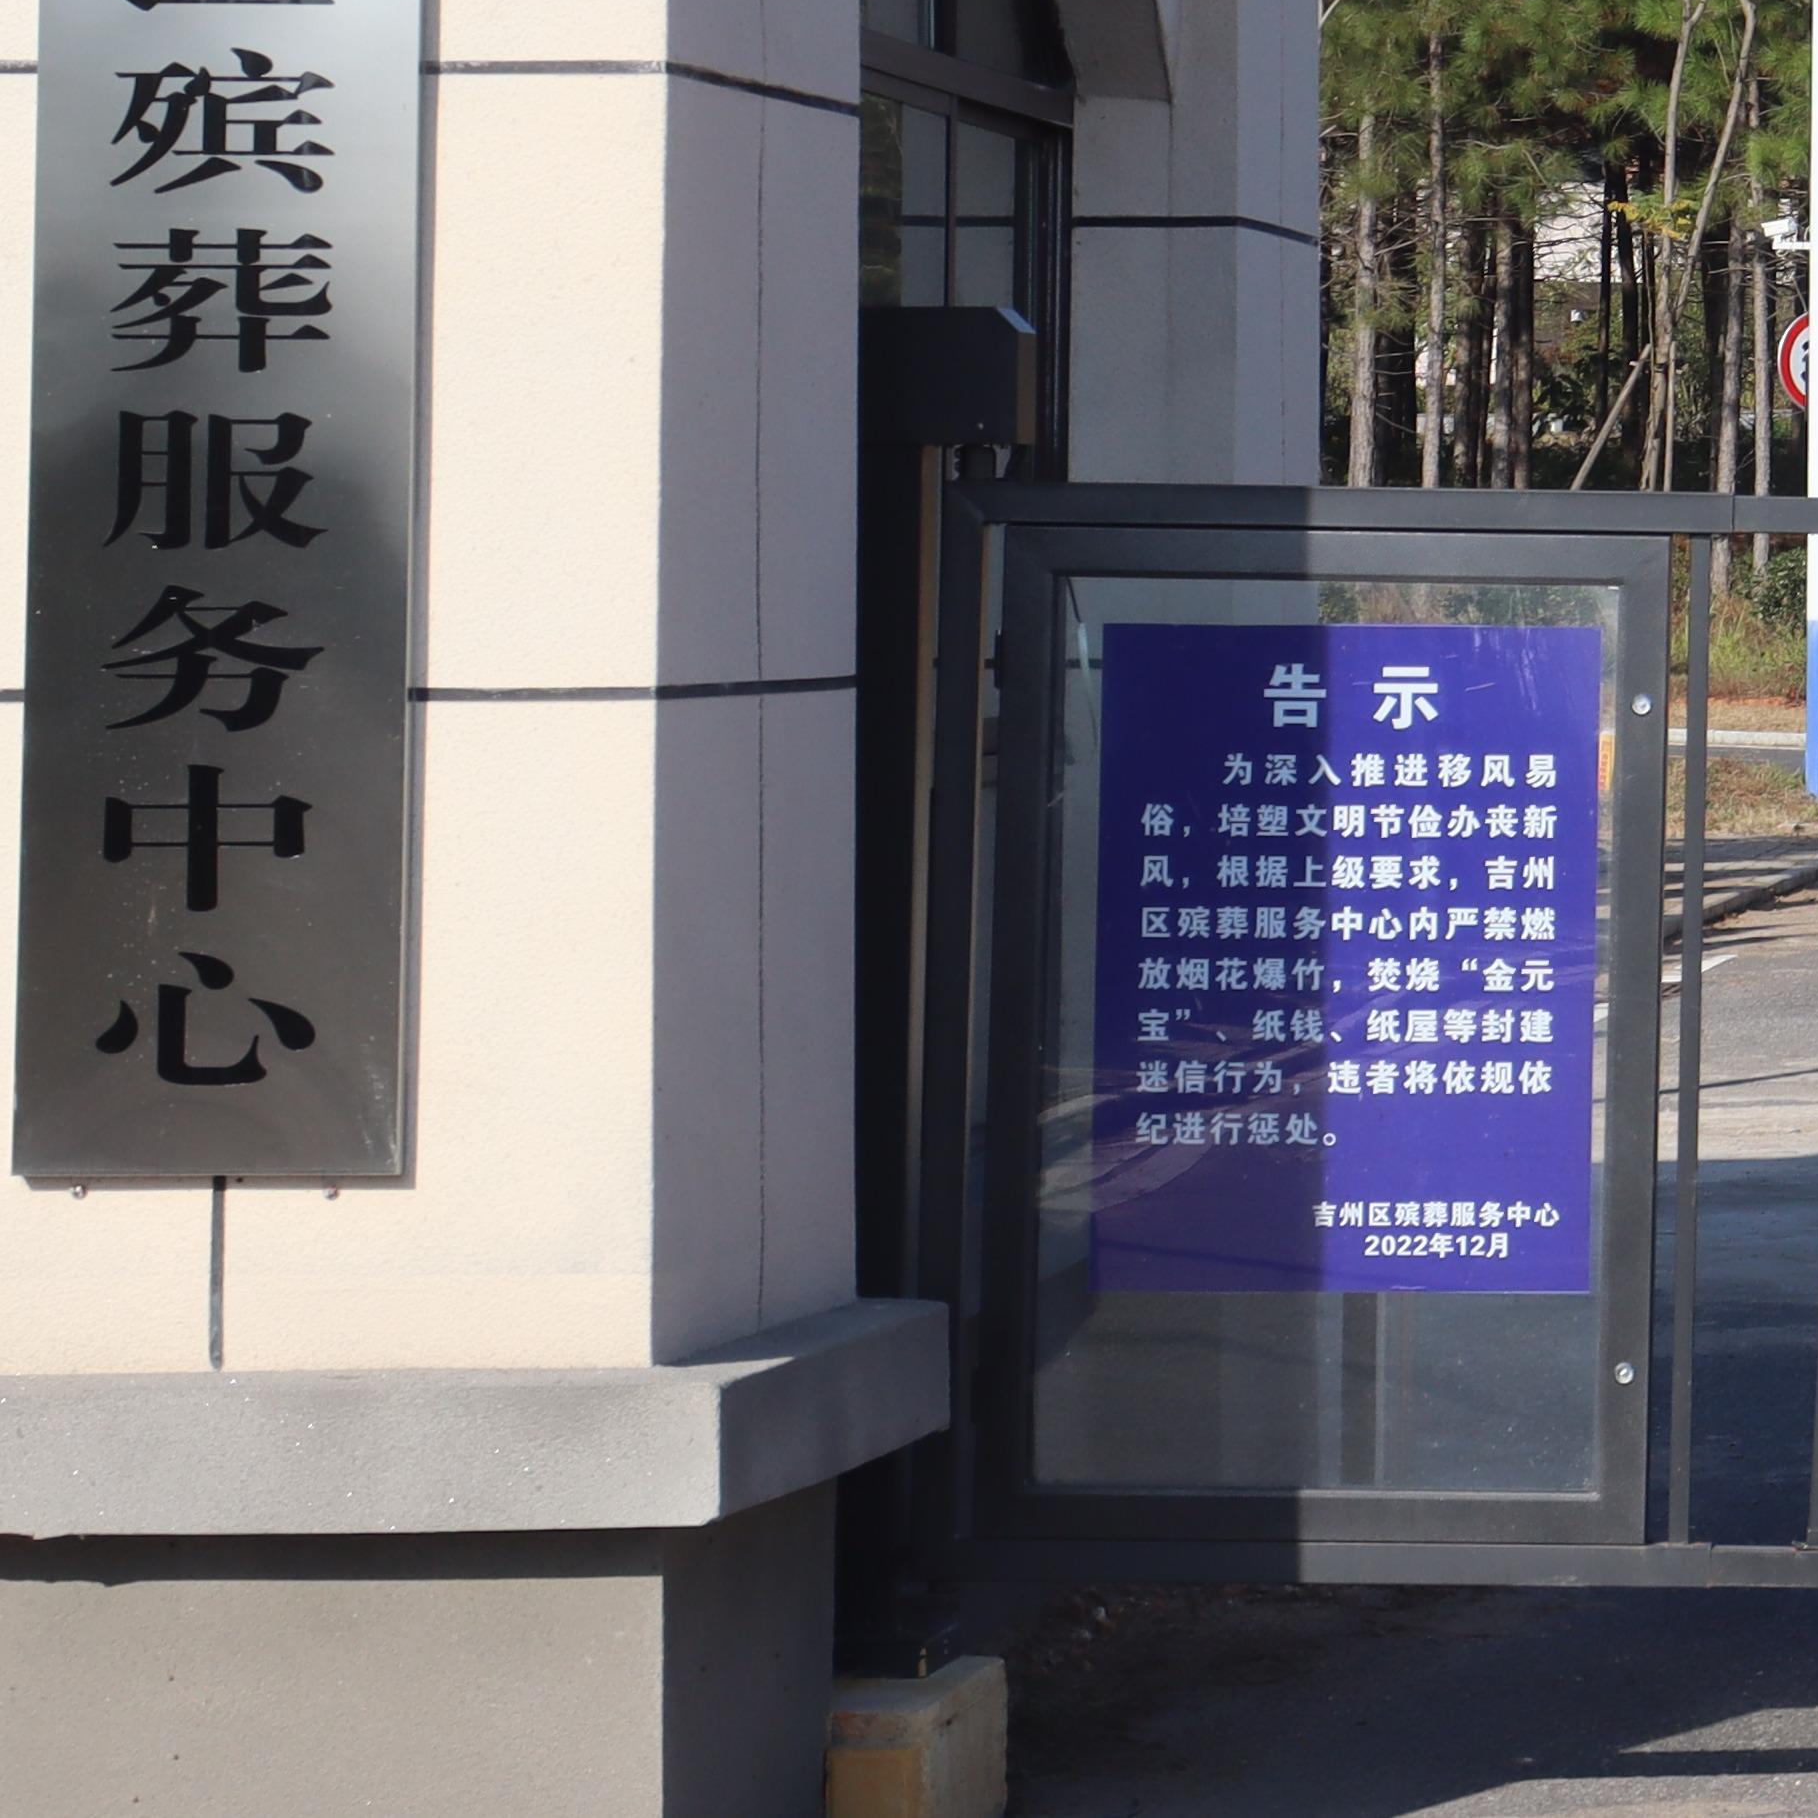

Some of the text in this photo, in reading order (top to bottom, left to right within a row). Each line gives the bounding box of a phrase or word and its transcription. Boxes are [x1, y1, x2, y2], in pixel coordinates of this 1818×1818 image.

[1263, 663, 1440, 729] 告示
[1223, 753, 1558, 788] 为深入推进移风易
[1141, 803, 1558, 842] 俗，培塑文明节俭办丧新
[1140, 856, 1556, 891] 风，根据上级要求，吉州
[1140, 907, 1556, 943] 区殡葬服务中心内严禁燃
[1138, 958, 1555, 994] 放烟花爆竹，焚烧“金元
[1137, 1009, 1555, 1044] 宝”、纸钱、纸屋等封建
[1136, 1060, 1553, 1095] 迷信行为，违者将依规依
[1135, 1112, 1338, 1148] 纪进行惩处。
[1312, 1201, 1560, 1229] 吉州区殡葬服务中心
[1364, 1233, 1510, 1259] 2022年12月
